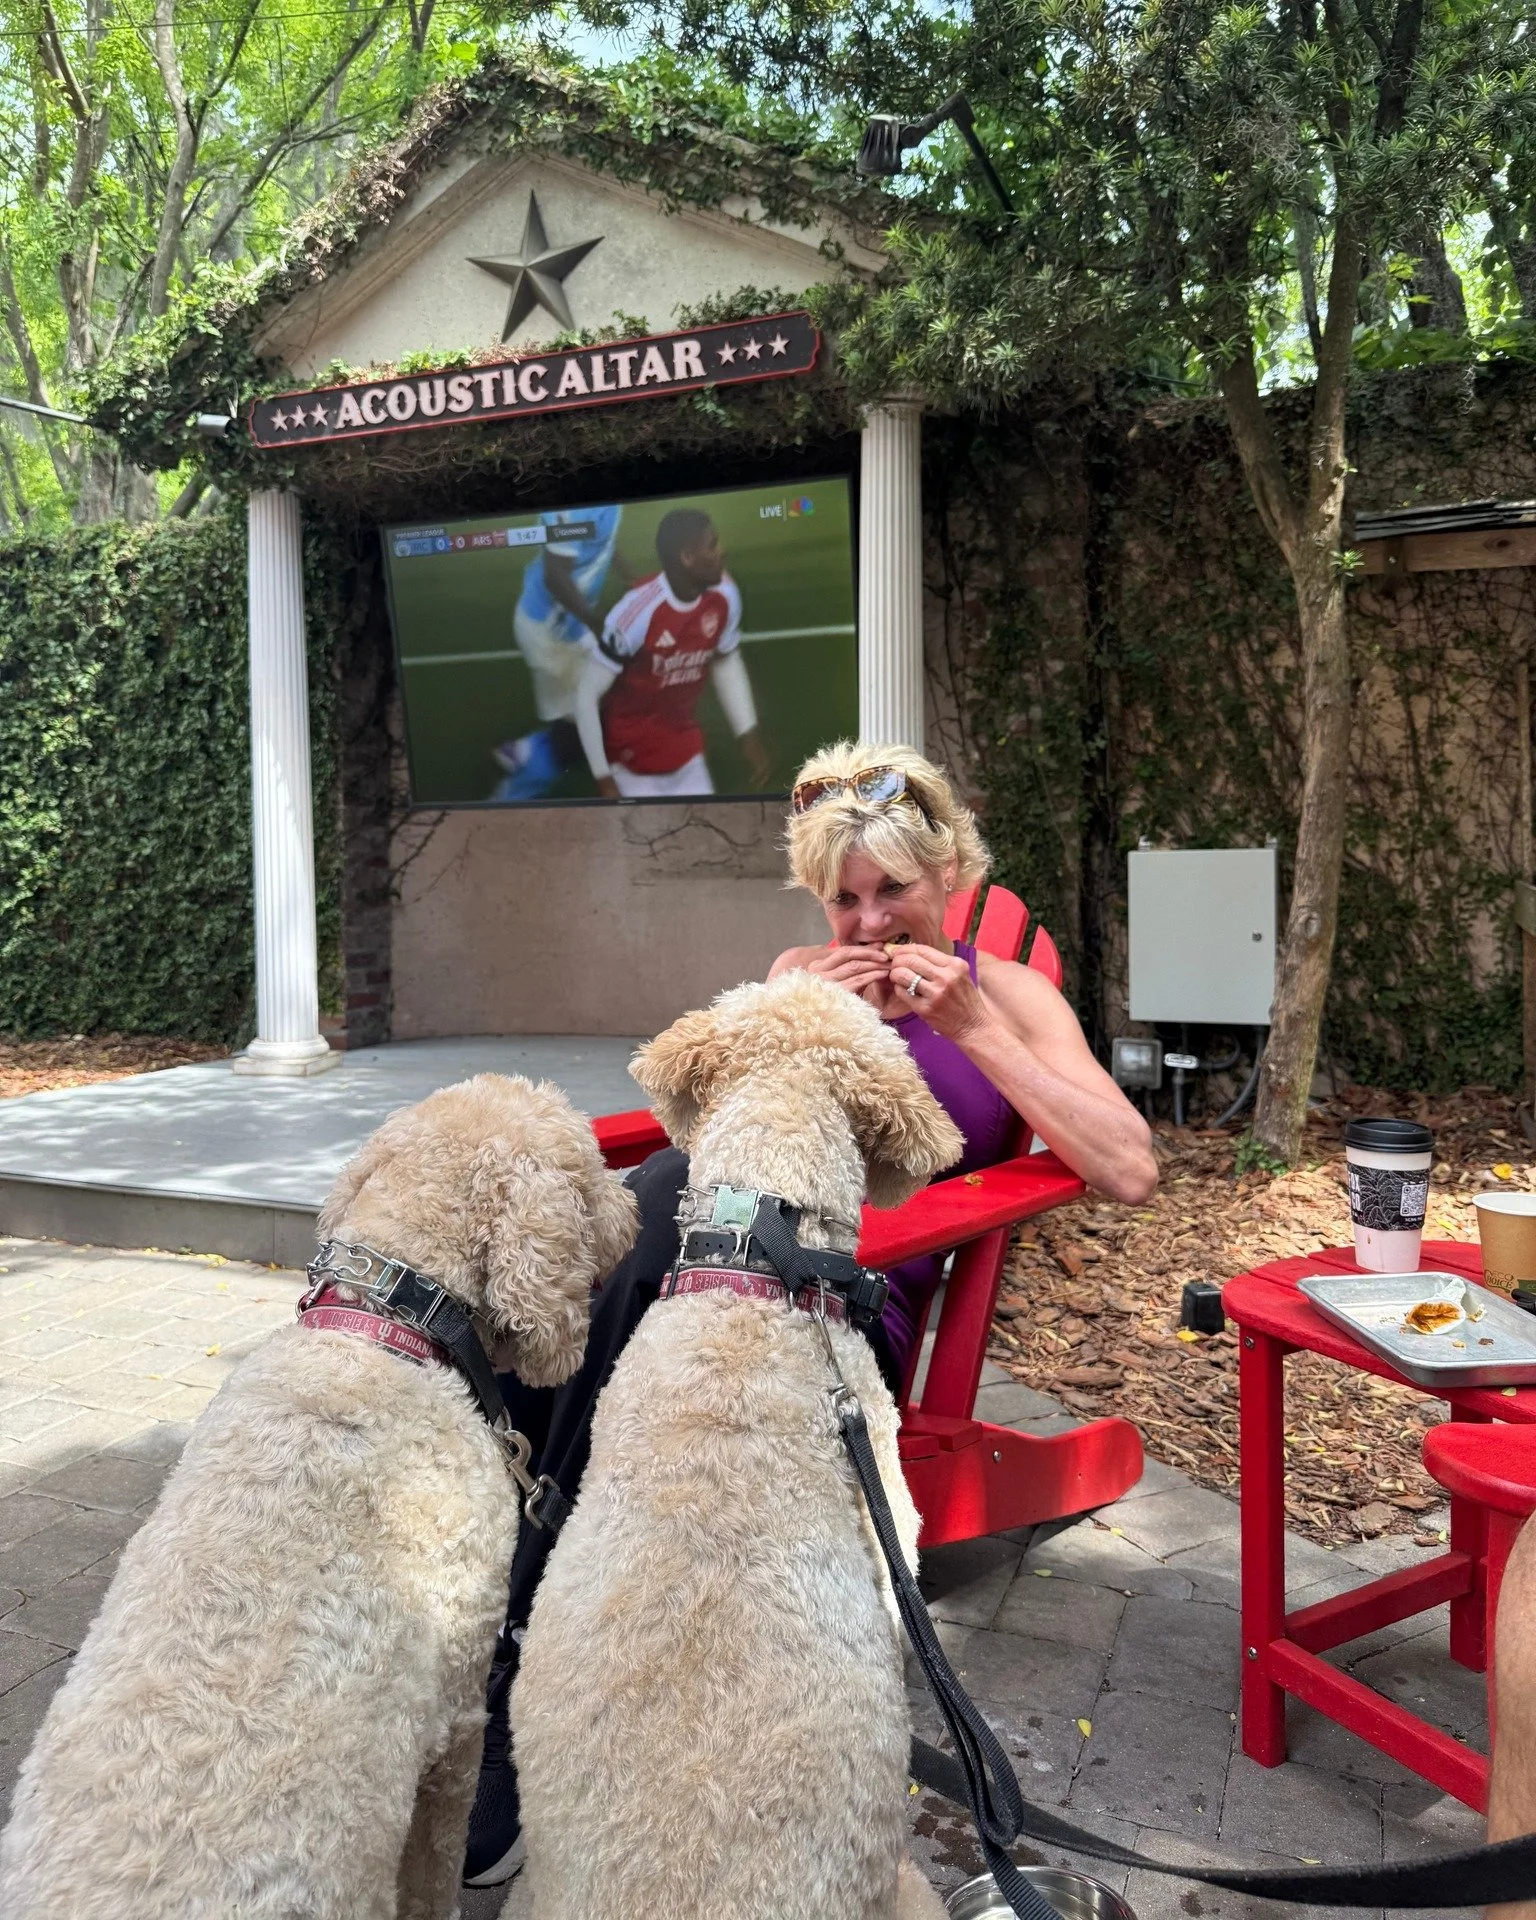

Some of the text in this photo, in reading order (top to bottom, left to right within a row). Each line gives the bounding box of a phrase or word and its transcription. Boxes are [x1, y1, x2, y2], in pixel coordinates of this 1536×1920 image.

[334, 339, 707, 429] ACOUSTIC ALTAR
[760, 504, 782, 518] LIVE
[324, 1311, 375, 1332] HOOSIERS
[394, 1331, 434, 1356] INDIANA
